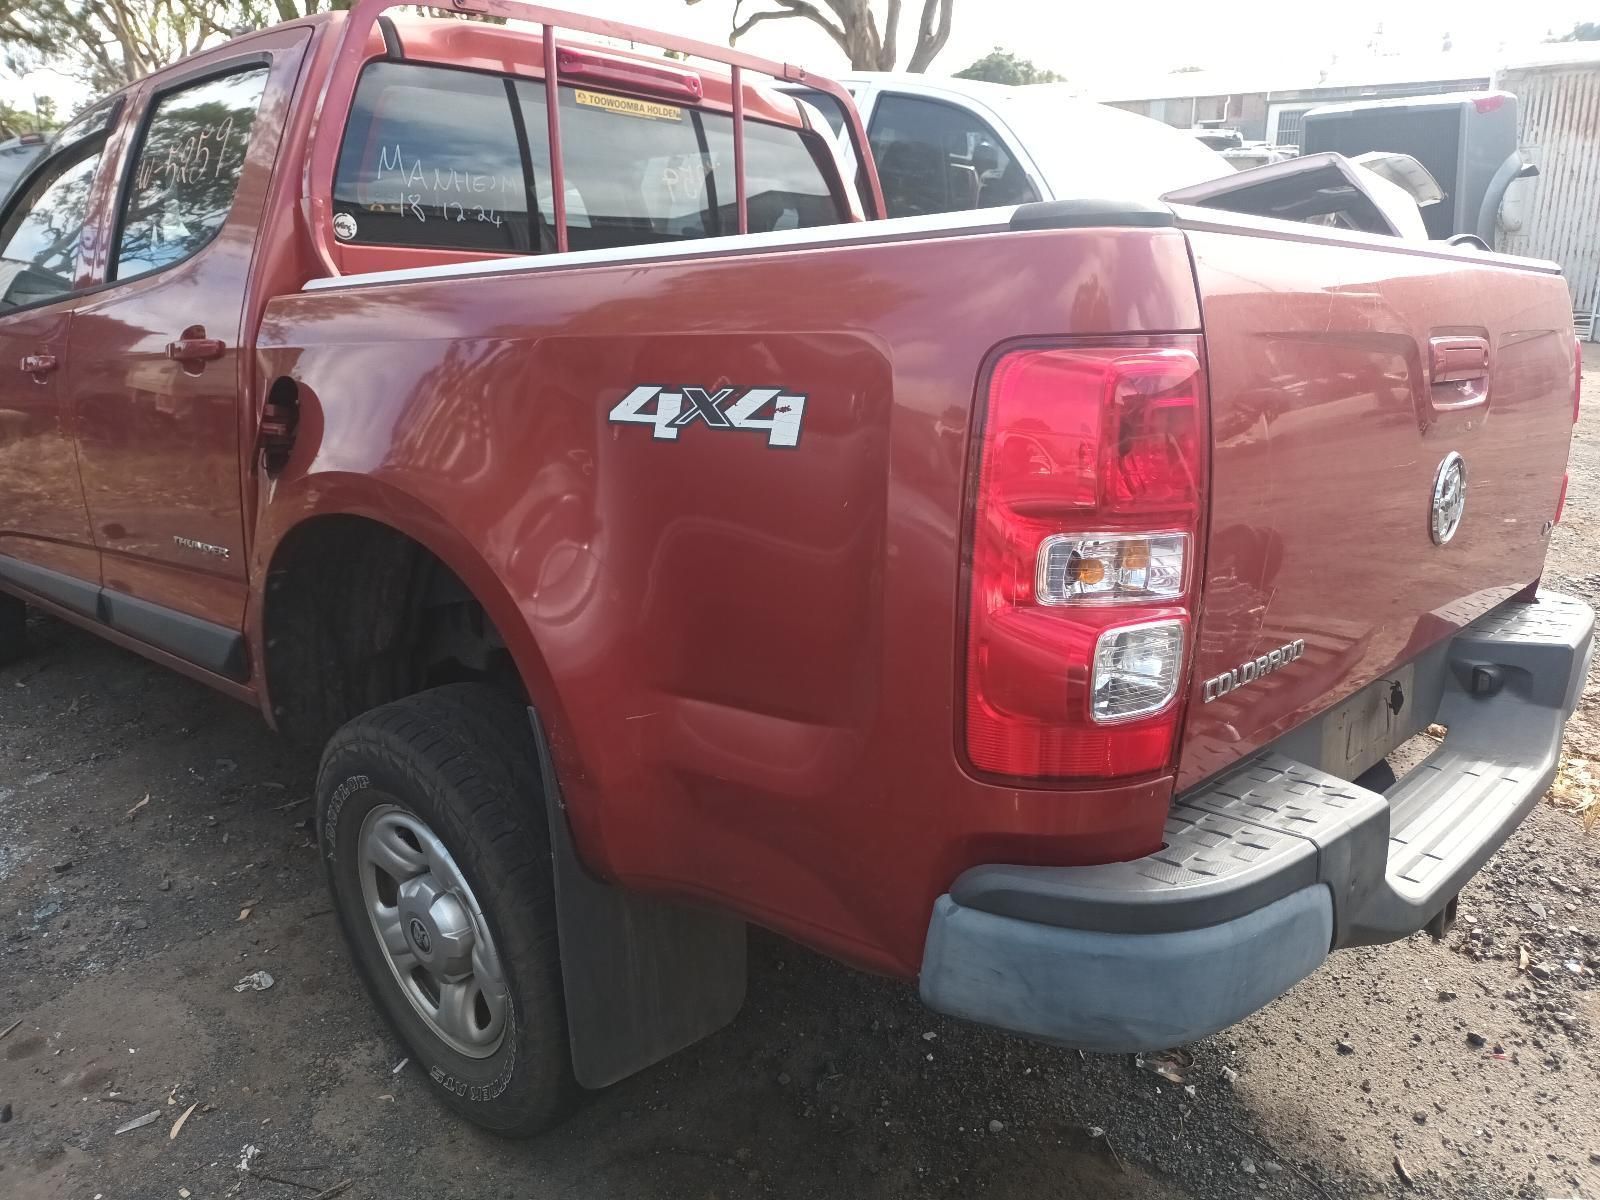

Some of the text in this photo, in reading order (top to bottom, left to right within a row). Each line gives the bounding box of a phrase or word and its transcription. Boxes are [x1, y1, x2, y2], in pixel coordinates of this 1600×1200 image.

[589, 94, 645, 113] TOOWOOMBA
[647, 105, 680, 119] HOLDEN
[1203, 638, 1305, 704] COLORADO
